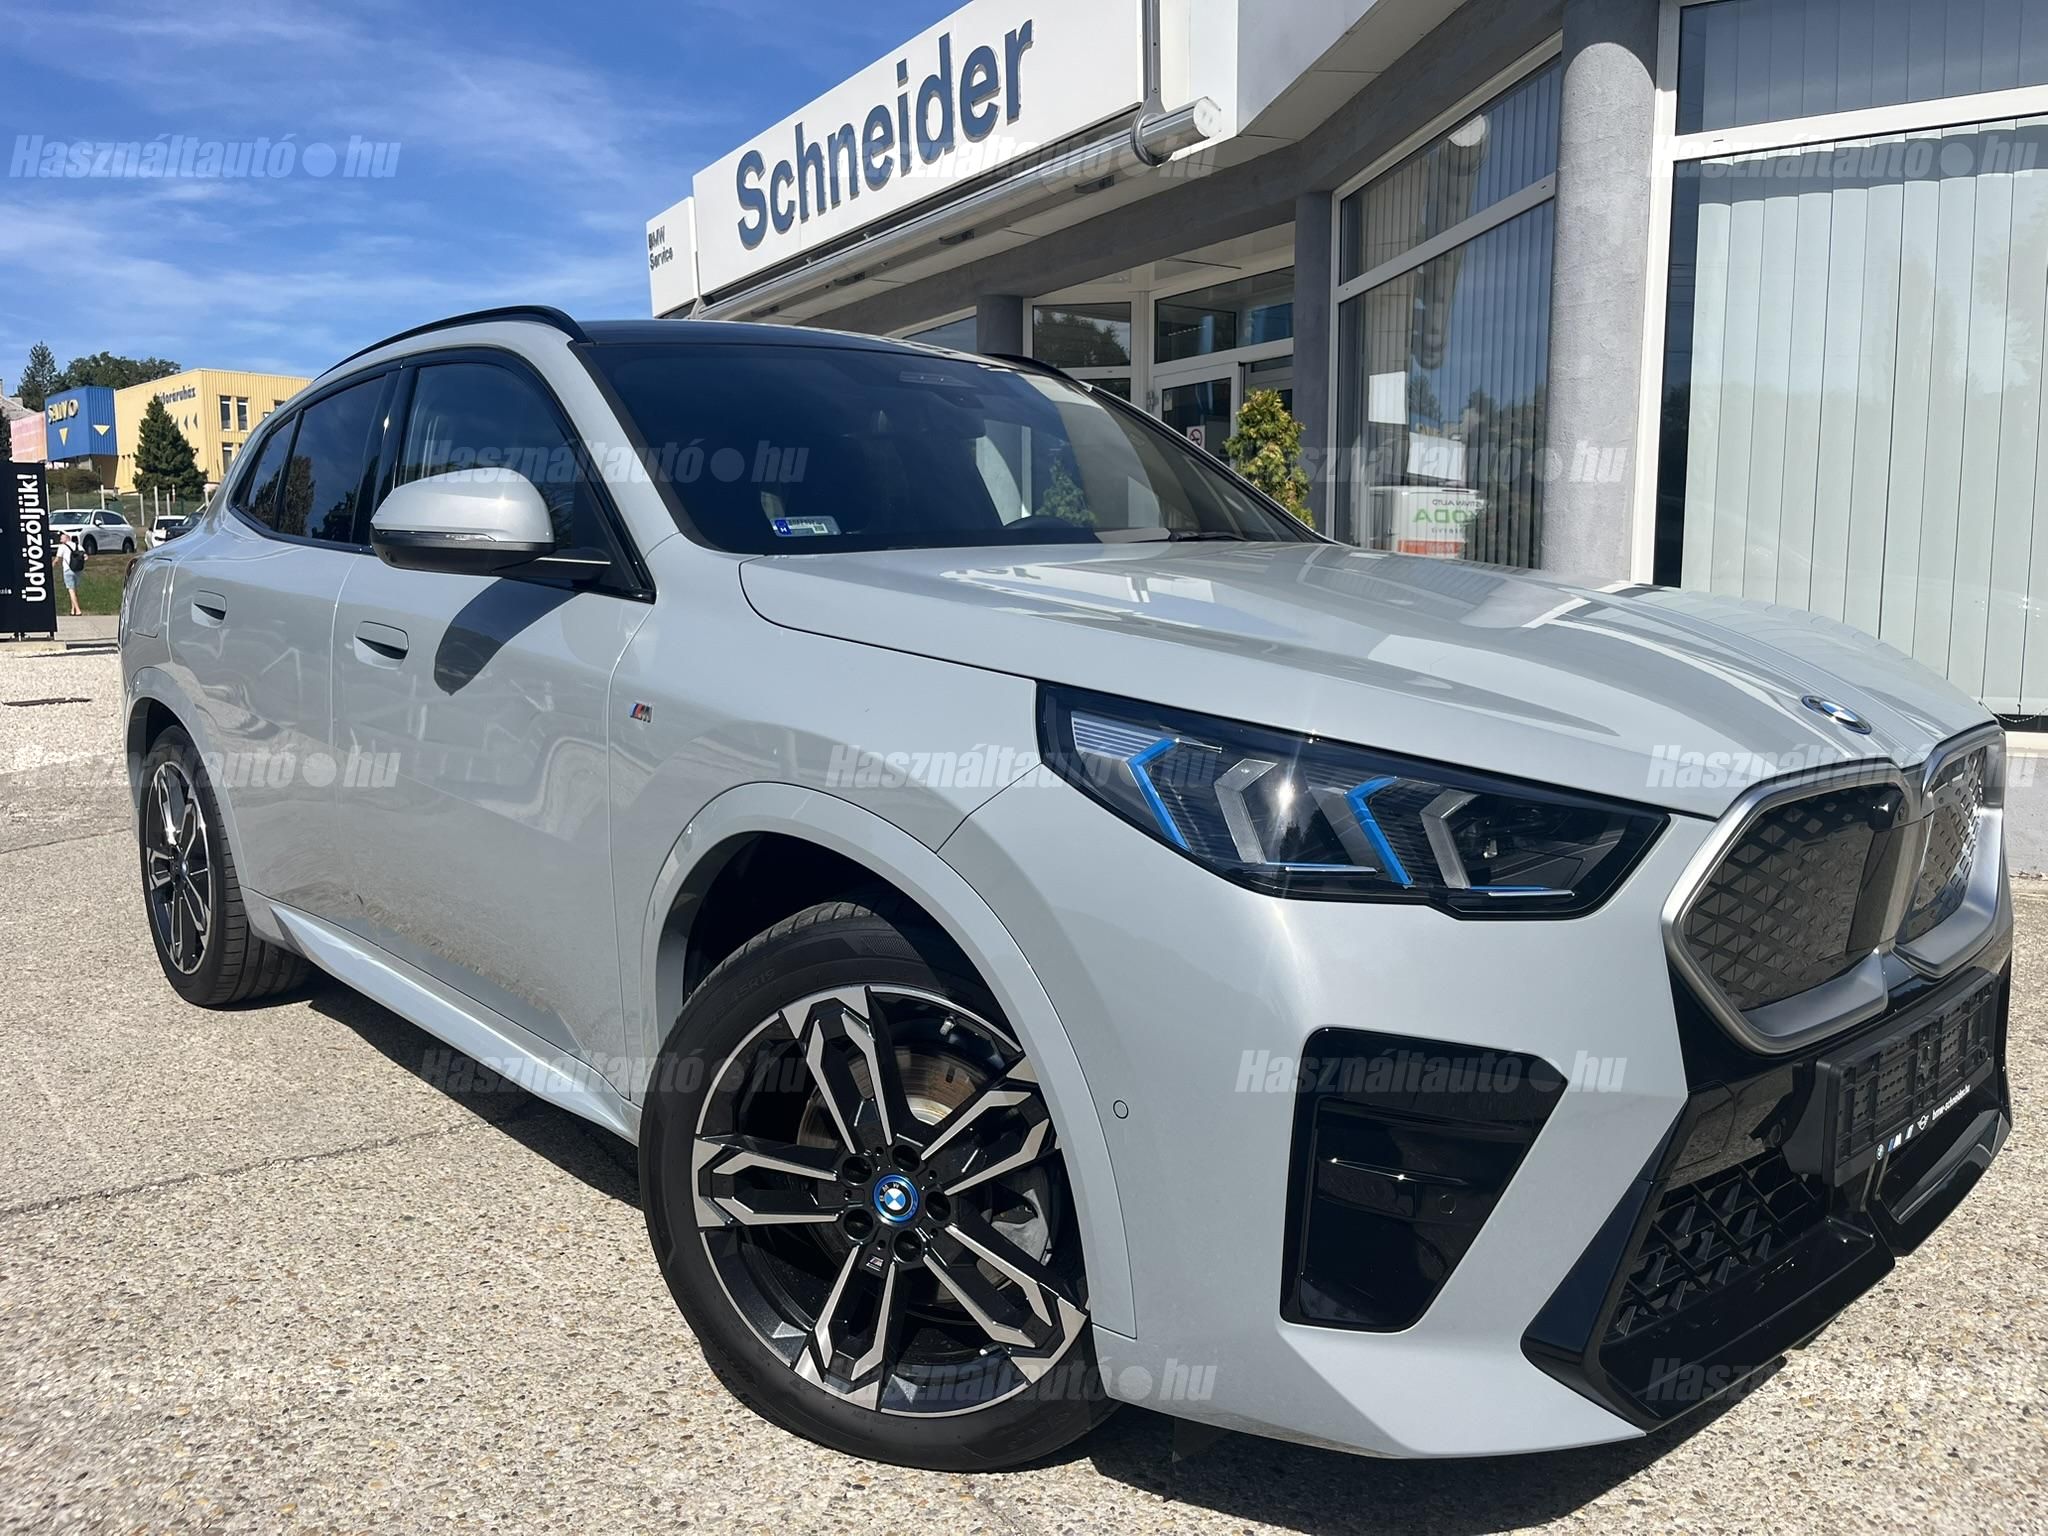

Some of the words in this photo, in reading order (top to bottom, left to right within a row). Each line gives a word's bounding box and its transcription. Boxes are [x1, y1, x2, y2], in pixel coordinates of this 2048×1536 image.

[736, 19, 1034, 250] Schneider
[648, 225, 665, 251] BMW
[650, 246, 673, 271] Service
[48, 399, 79, 423] SALVO
[17, 474, 46, 602] Üdvözöljük!
